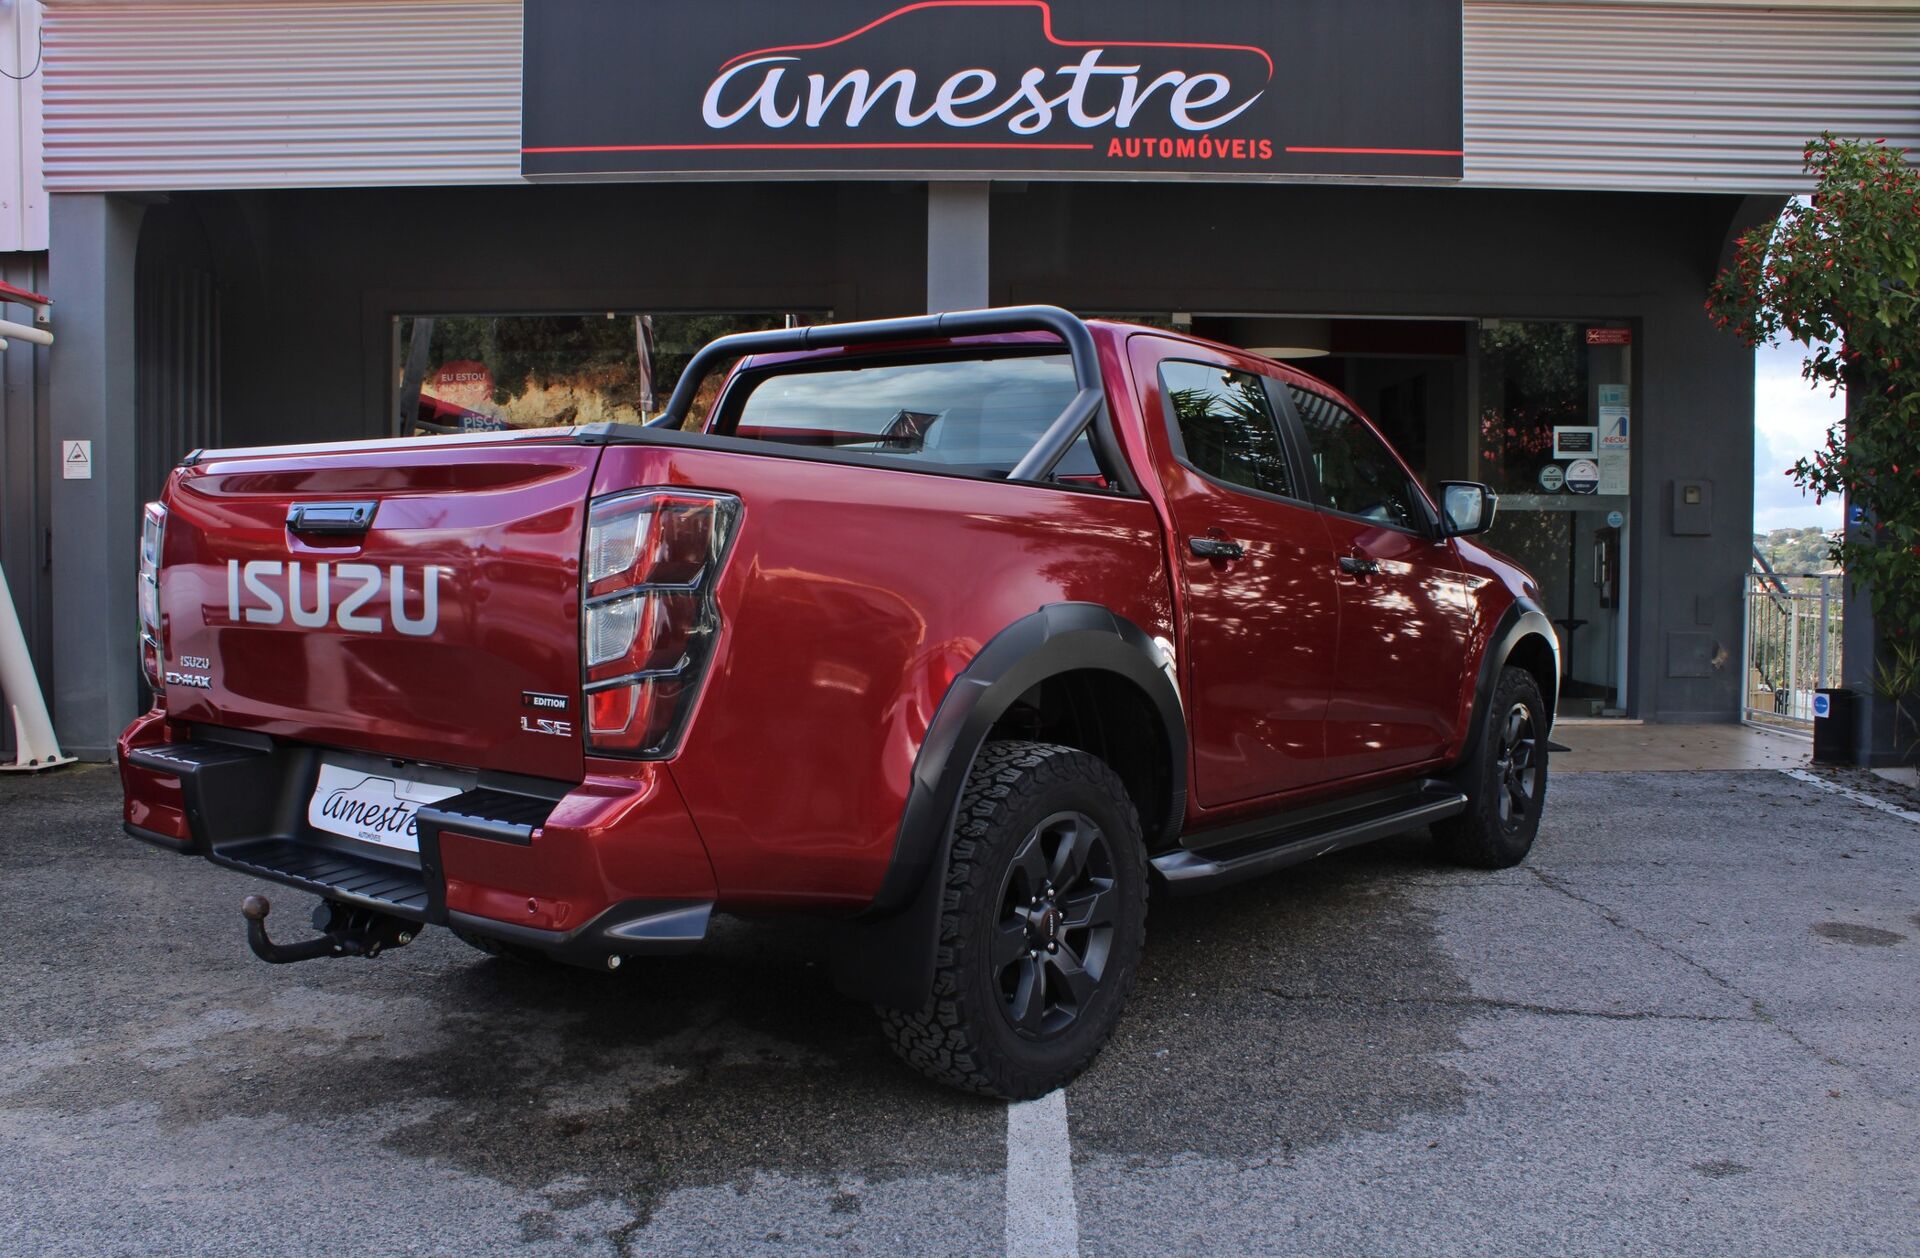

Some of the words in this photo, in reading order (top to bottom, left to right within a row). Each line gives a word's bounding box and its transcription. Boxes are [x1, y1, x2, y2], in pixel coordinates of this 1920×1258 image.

[702, 49, 1264, 135] amestre
[1106, 134, 1273, 160] AUTOMÓVEIS
[441, 373, 454, 382] EU
[456, 373, 486, 381] ESTOU
[228, 559, 438, 636] ISUZU
[180, 655, 210, 669] ISUZU
[165, 671, 213, 690] D-MAX
[533, 697, 566, 709] EDITION
[520, 716, 572, 737] LSE
